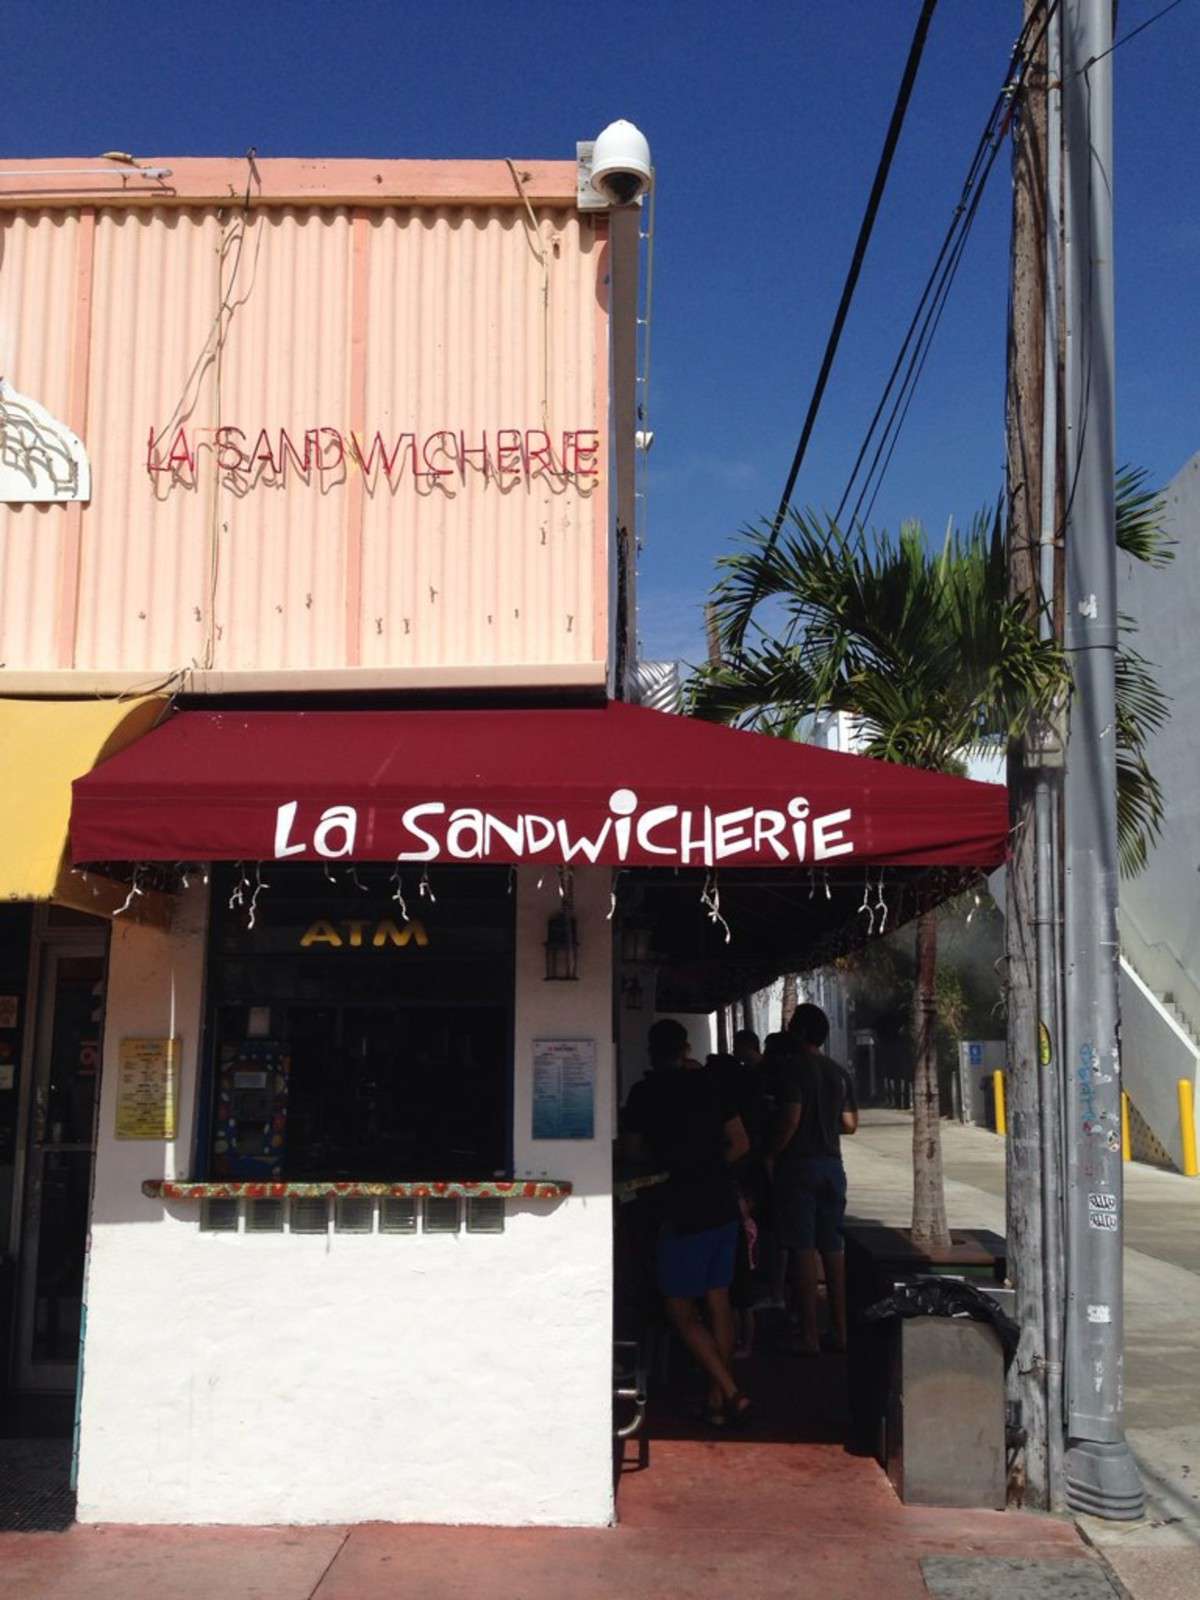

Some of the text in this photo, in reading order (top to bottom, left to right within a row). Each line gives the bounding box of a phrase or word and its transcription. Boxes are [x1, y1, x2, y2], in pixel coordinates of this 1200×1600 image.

[147, 426, 599, 476] LA SANDWICHERIE
[274, 800, 357, 859] La
[300, 919, 429, 947] ATM
